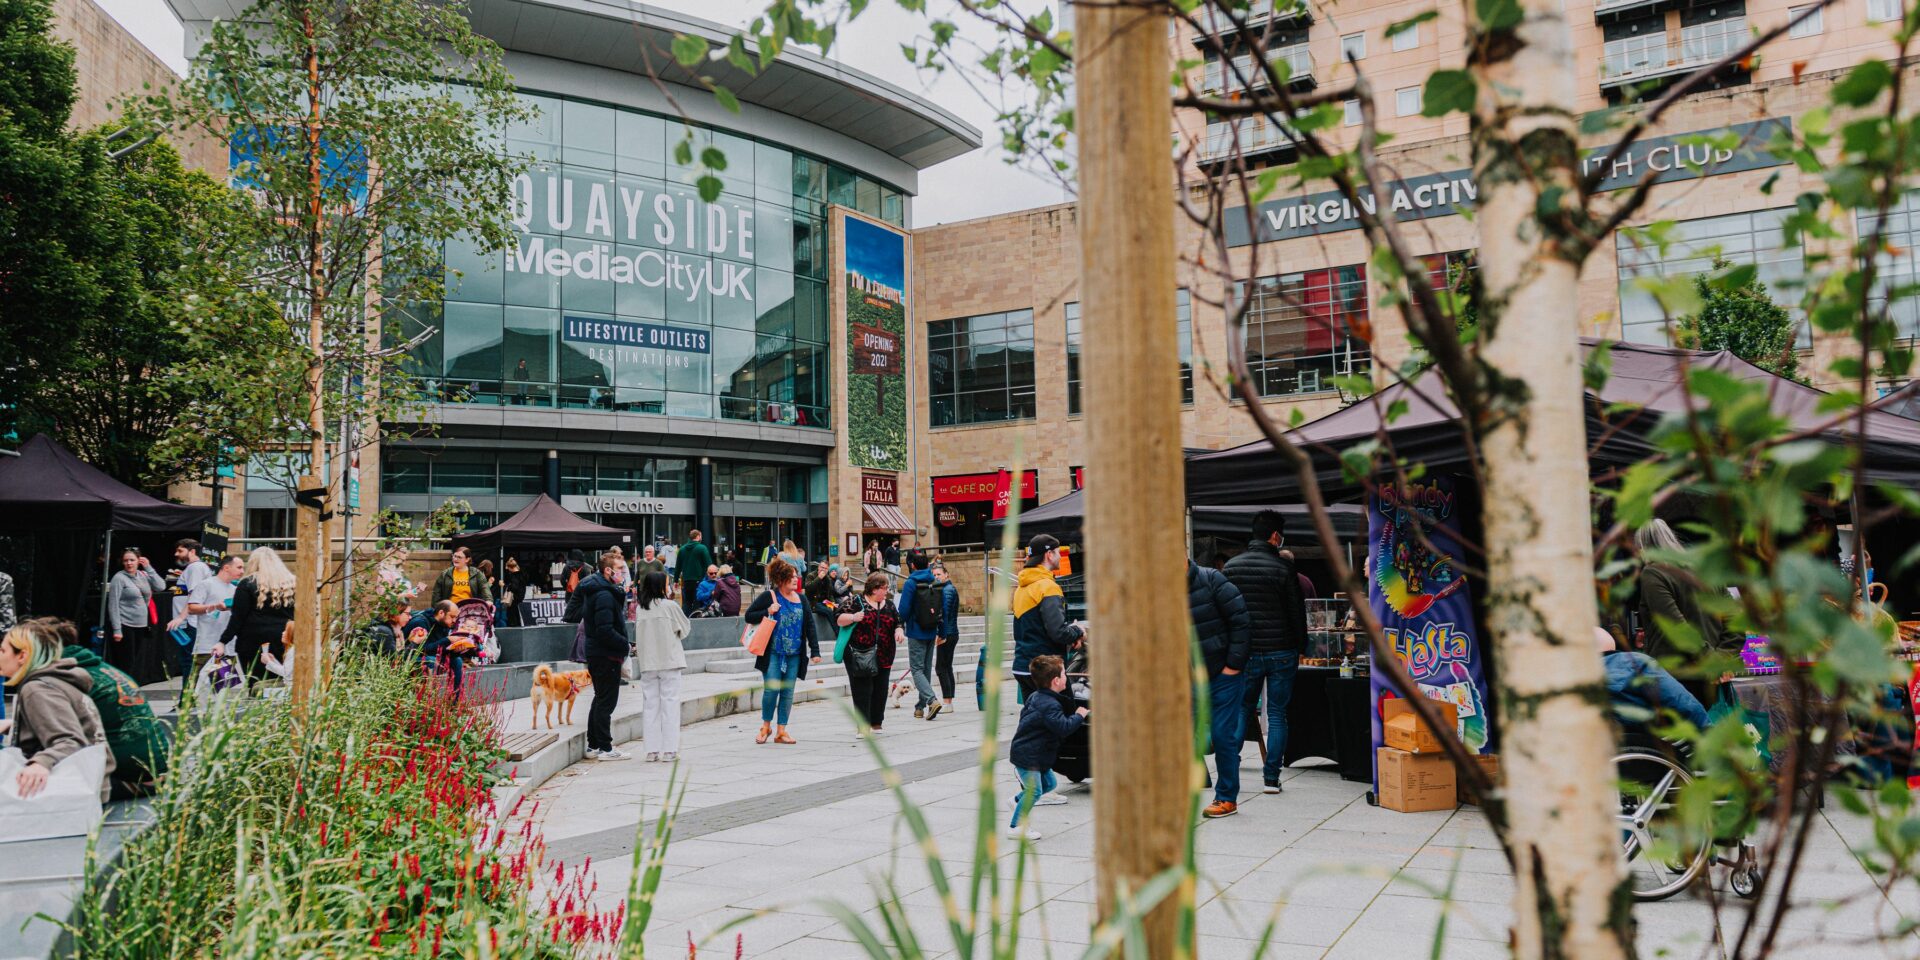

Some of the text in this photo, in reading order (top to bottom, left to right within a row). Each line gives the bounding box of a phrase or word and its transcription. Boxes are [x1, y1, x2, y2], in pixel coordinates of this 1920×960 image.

[1266, 193, 1376, 231] VIRGIN
[1391, 178, 1478, 214] ACTIV
[1647, 143, 1733, 172] CLUB
[511, 173, 753, 260] QUAYSIDE
[505, 236, 753, 302] MediaCityUK
[569, 320, 706, 350] LIFESTYLE OUTLETS
[864, 333, 894, 352] OPENING
[589, 347, 689, 368] DESTINATIONS
[870, 353, 887, 367] 2021
[866, 478, 892, 491] BELLA
[586, 496, 665, 513] Welcome
[865, 490, 894, 502] ITALIA
